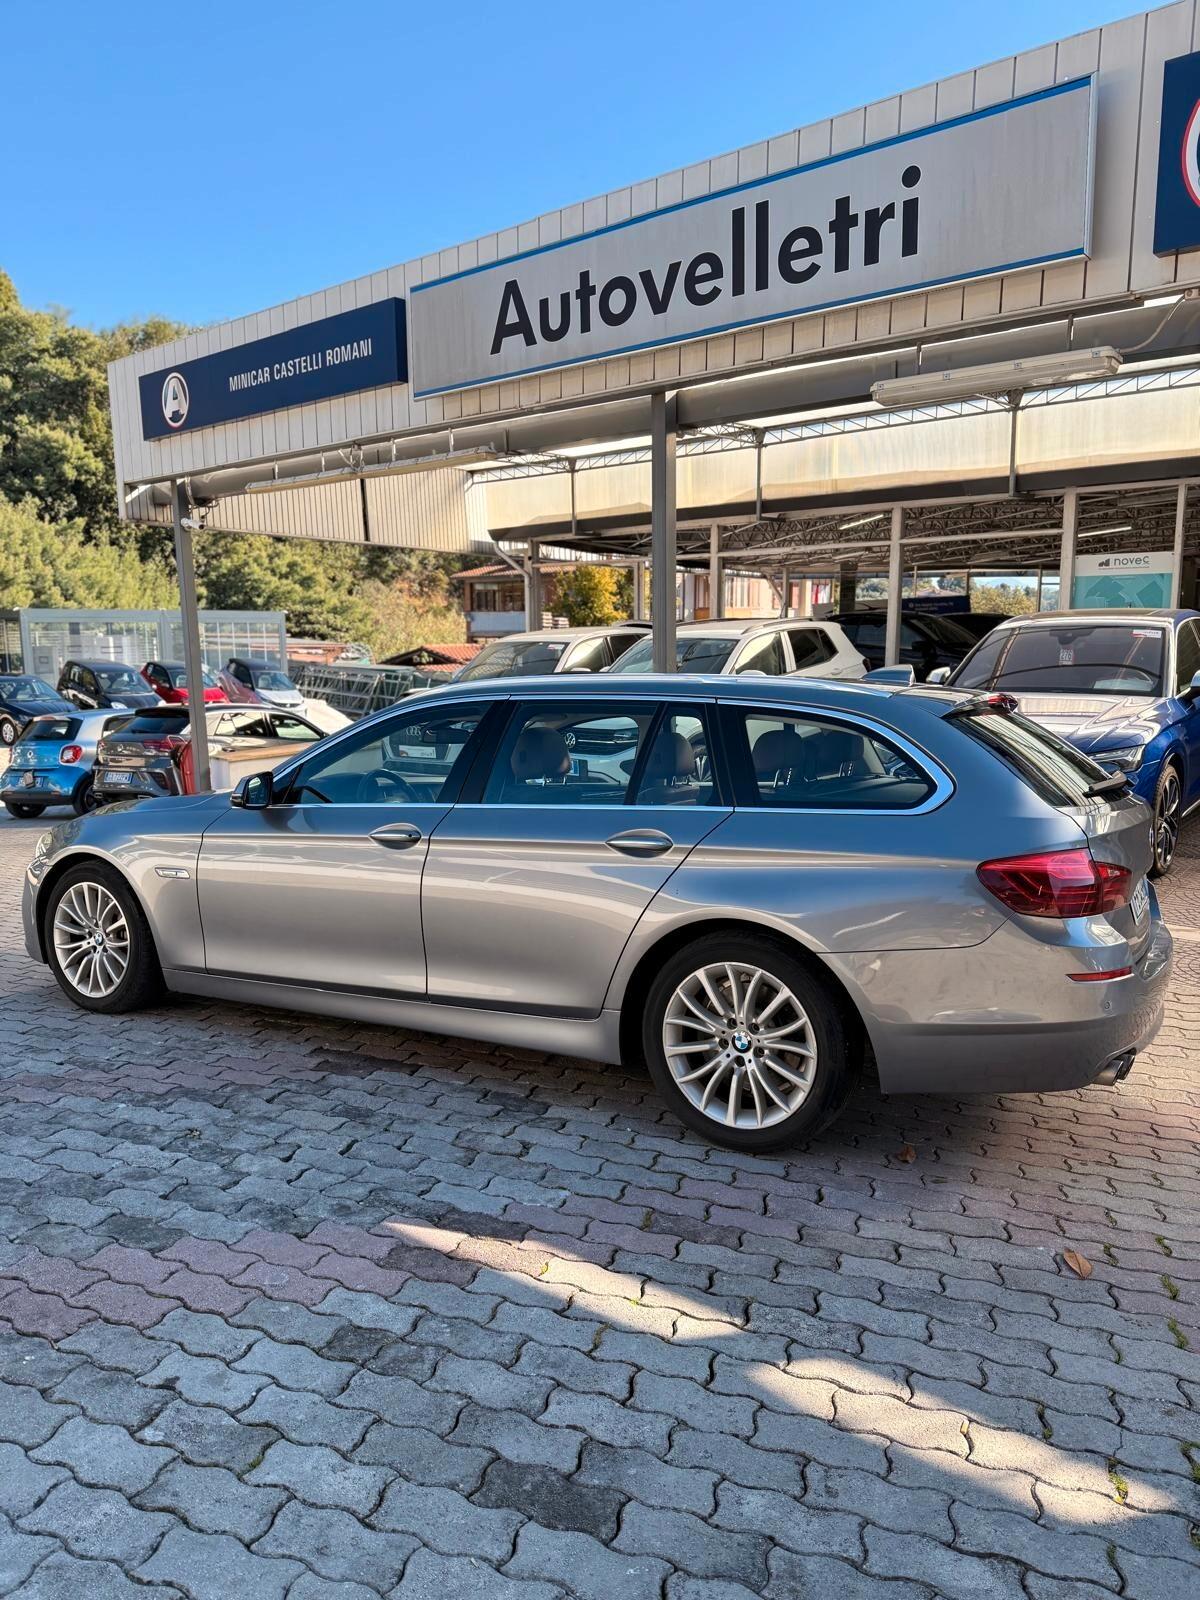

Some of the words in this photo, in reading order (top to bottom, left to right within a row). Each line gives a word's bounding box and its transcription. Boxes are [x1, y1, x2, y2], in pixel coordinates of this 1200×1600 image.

[490, 165, 922, 355] Autovelletri
[229, 367, 270, 392] MINICAR
[274, 353, 322, 380] CASTELLI
[326, 338, 373, 366] ROMANI
